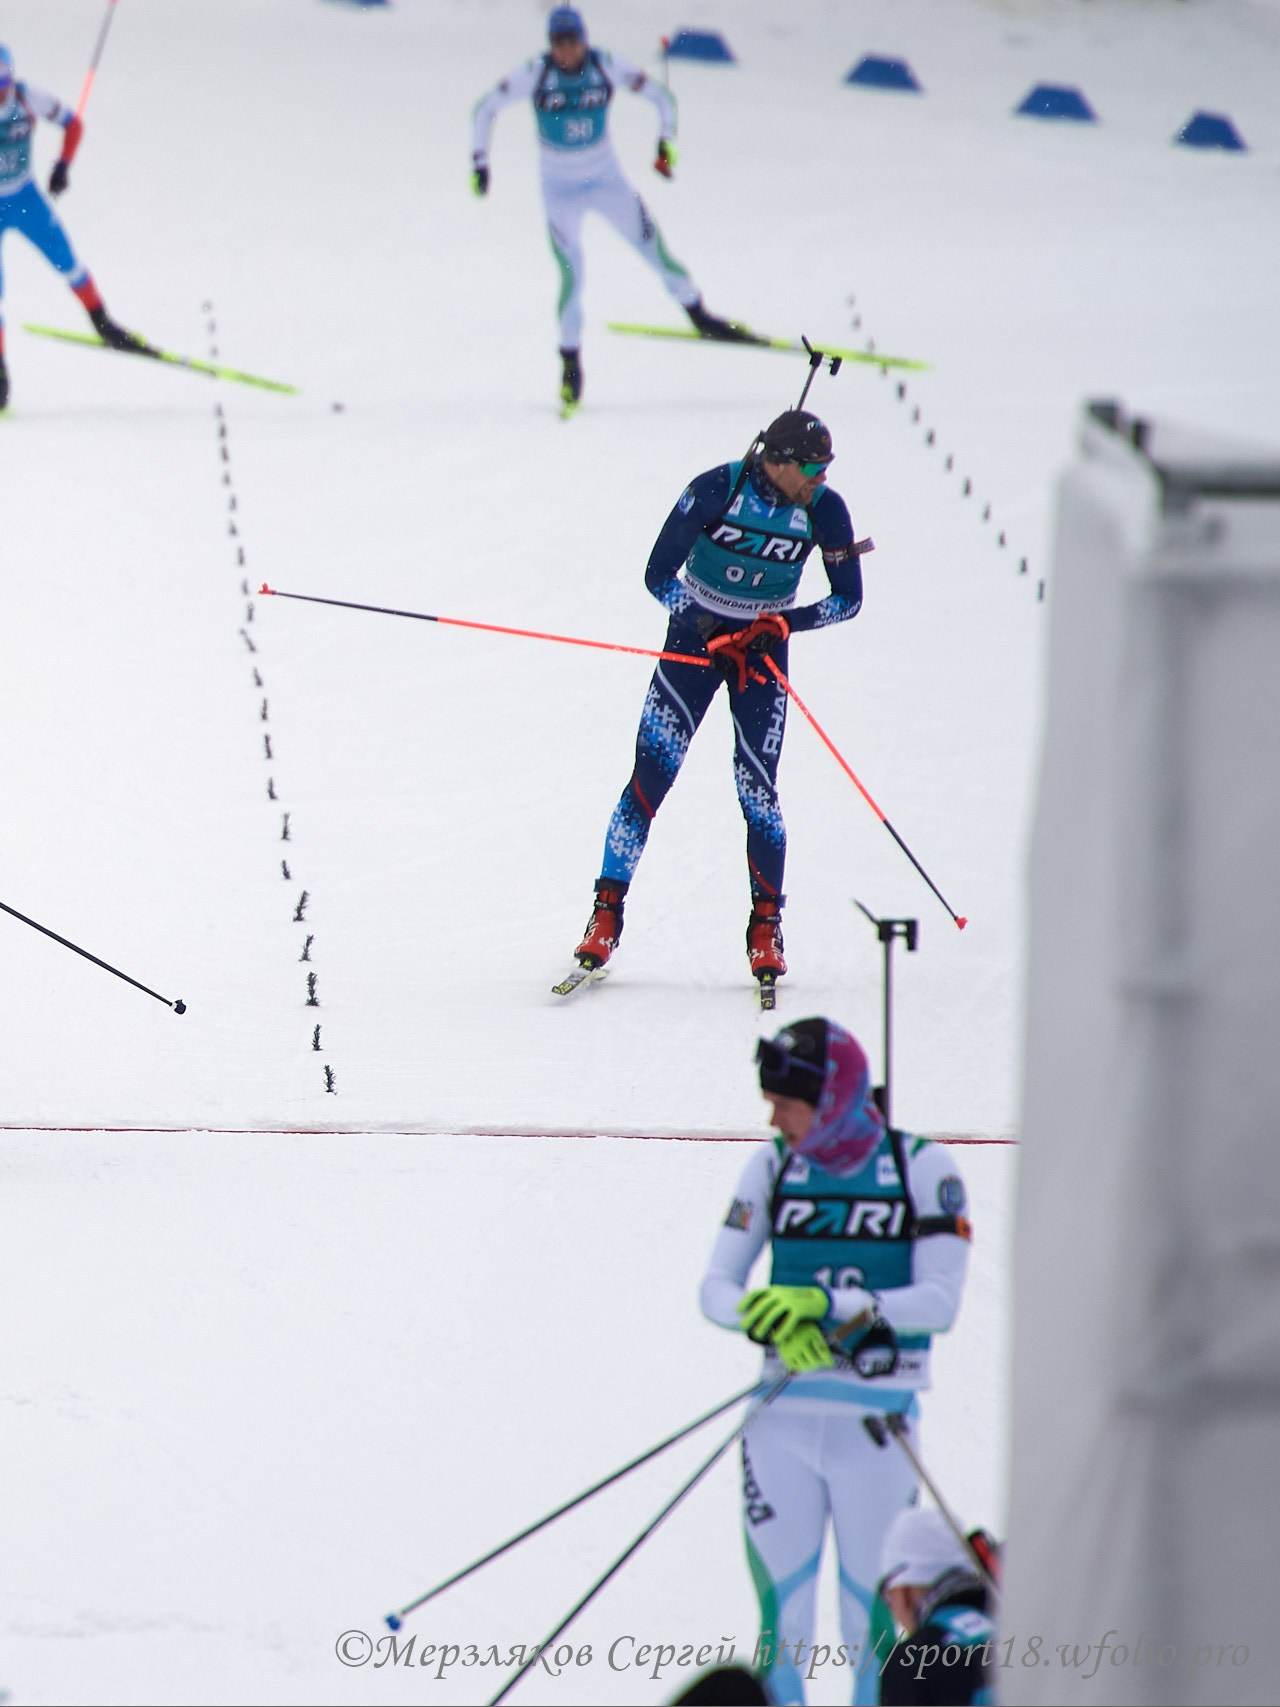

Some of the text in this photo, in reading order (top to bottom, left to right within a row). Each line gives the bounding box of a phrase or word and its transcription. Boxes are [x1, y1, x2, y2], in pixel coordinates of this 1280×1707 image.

[711, 524, 803, 561] PARI
[699, 586, 760, 611] ЧЕМПИОНАТ
[774, 1199, 907, 1238] PARI
